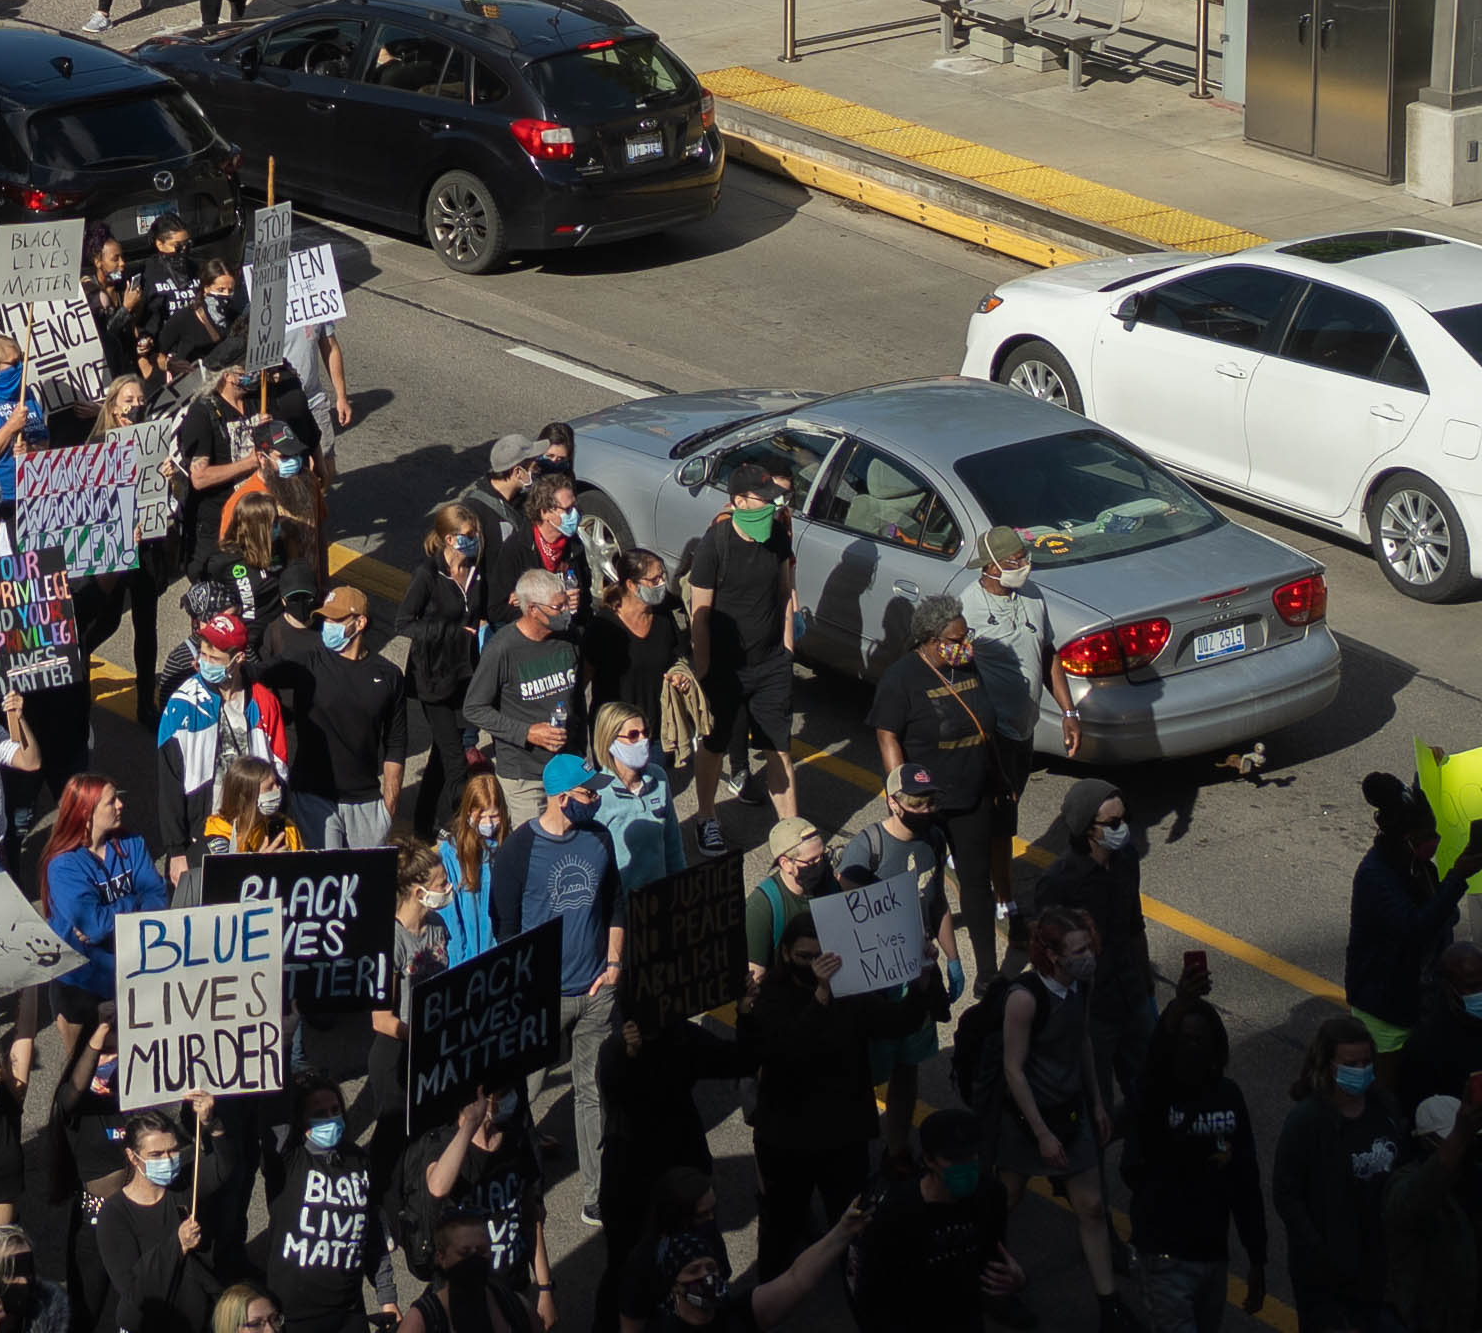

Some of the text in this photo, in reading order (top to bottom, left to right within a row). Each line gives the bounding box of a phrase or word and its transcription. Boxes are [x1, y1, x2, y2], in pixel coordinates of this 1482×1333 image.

[11, 227, 62, 251] BLACK
[256, 211, 290, 245] STOP
[12, 249, 70, 271] LIVES
[1, 274, 72, 297] MATTER
[23, 445, 135, 496] MAKE ME
[23, 487, 113, 532] WANNA
[19, 601, 64, 629] YOUR
[520, 671, 565, 697] SPARTANS
[667, 859, 738, 909] JUSTICE
[845, 887, 903, 924] Black
[671, 894, 739, 945] PEACE
[858, 928, 907, 954] Lives
[126, 907, 274, 979] BLUE
[423, 943, 533, 1033] BLACK
[862, 952, 923, 988] Matter
[128, 970, 268, 1029] LIVES
[438, 990, 522, 1058] LIVES
[125, 1021, 282, 1097] MURDER
[415, 1008, 548, 1105] MATTER!
